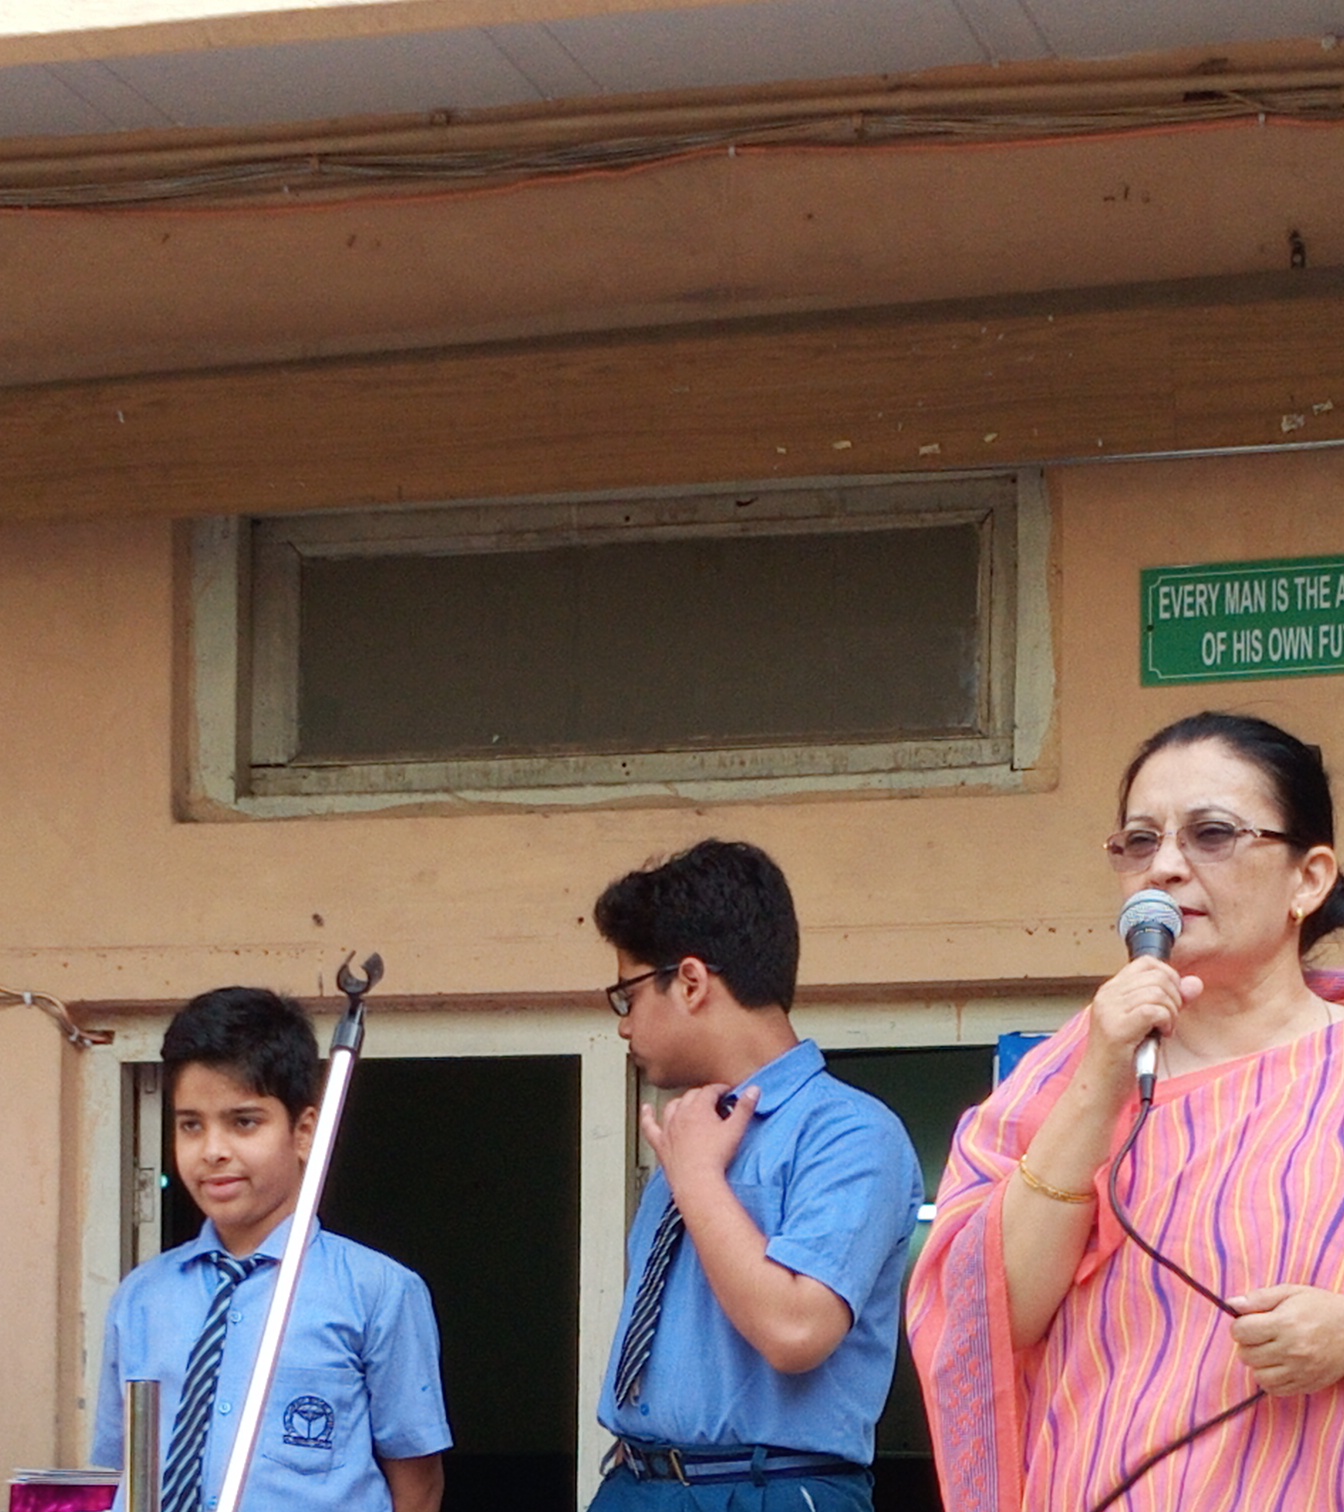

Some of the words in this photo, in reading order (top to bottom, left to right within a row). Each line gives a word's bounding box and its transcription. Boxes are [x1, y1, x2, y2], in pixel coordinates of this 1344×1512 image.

[1159, 583, 1221, 619] EVERY
[1225, 580, 1266, 615] MAN
[1271, 578, 1289, 612] IS
[1294, 575, 1330, 610] THE
[1201, 631, 1227, 666] OF
[1232, 627, 1262, 664] HIS
[1268, 625, 1313, 661] OWN
